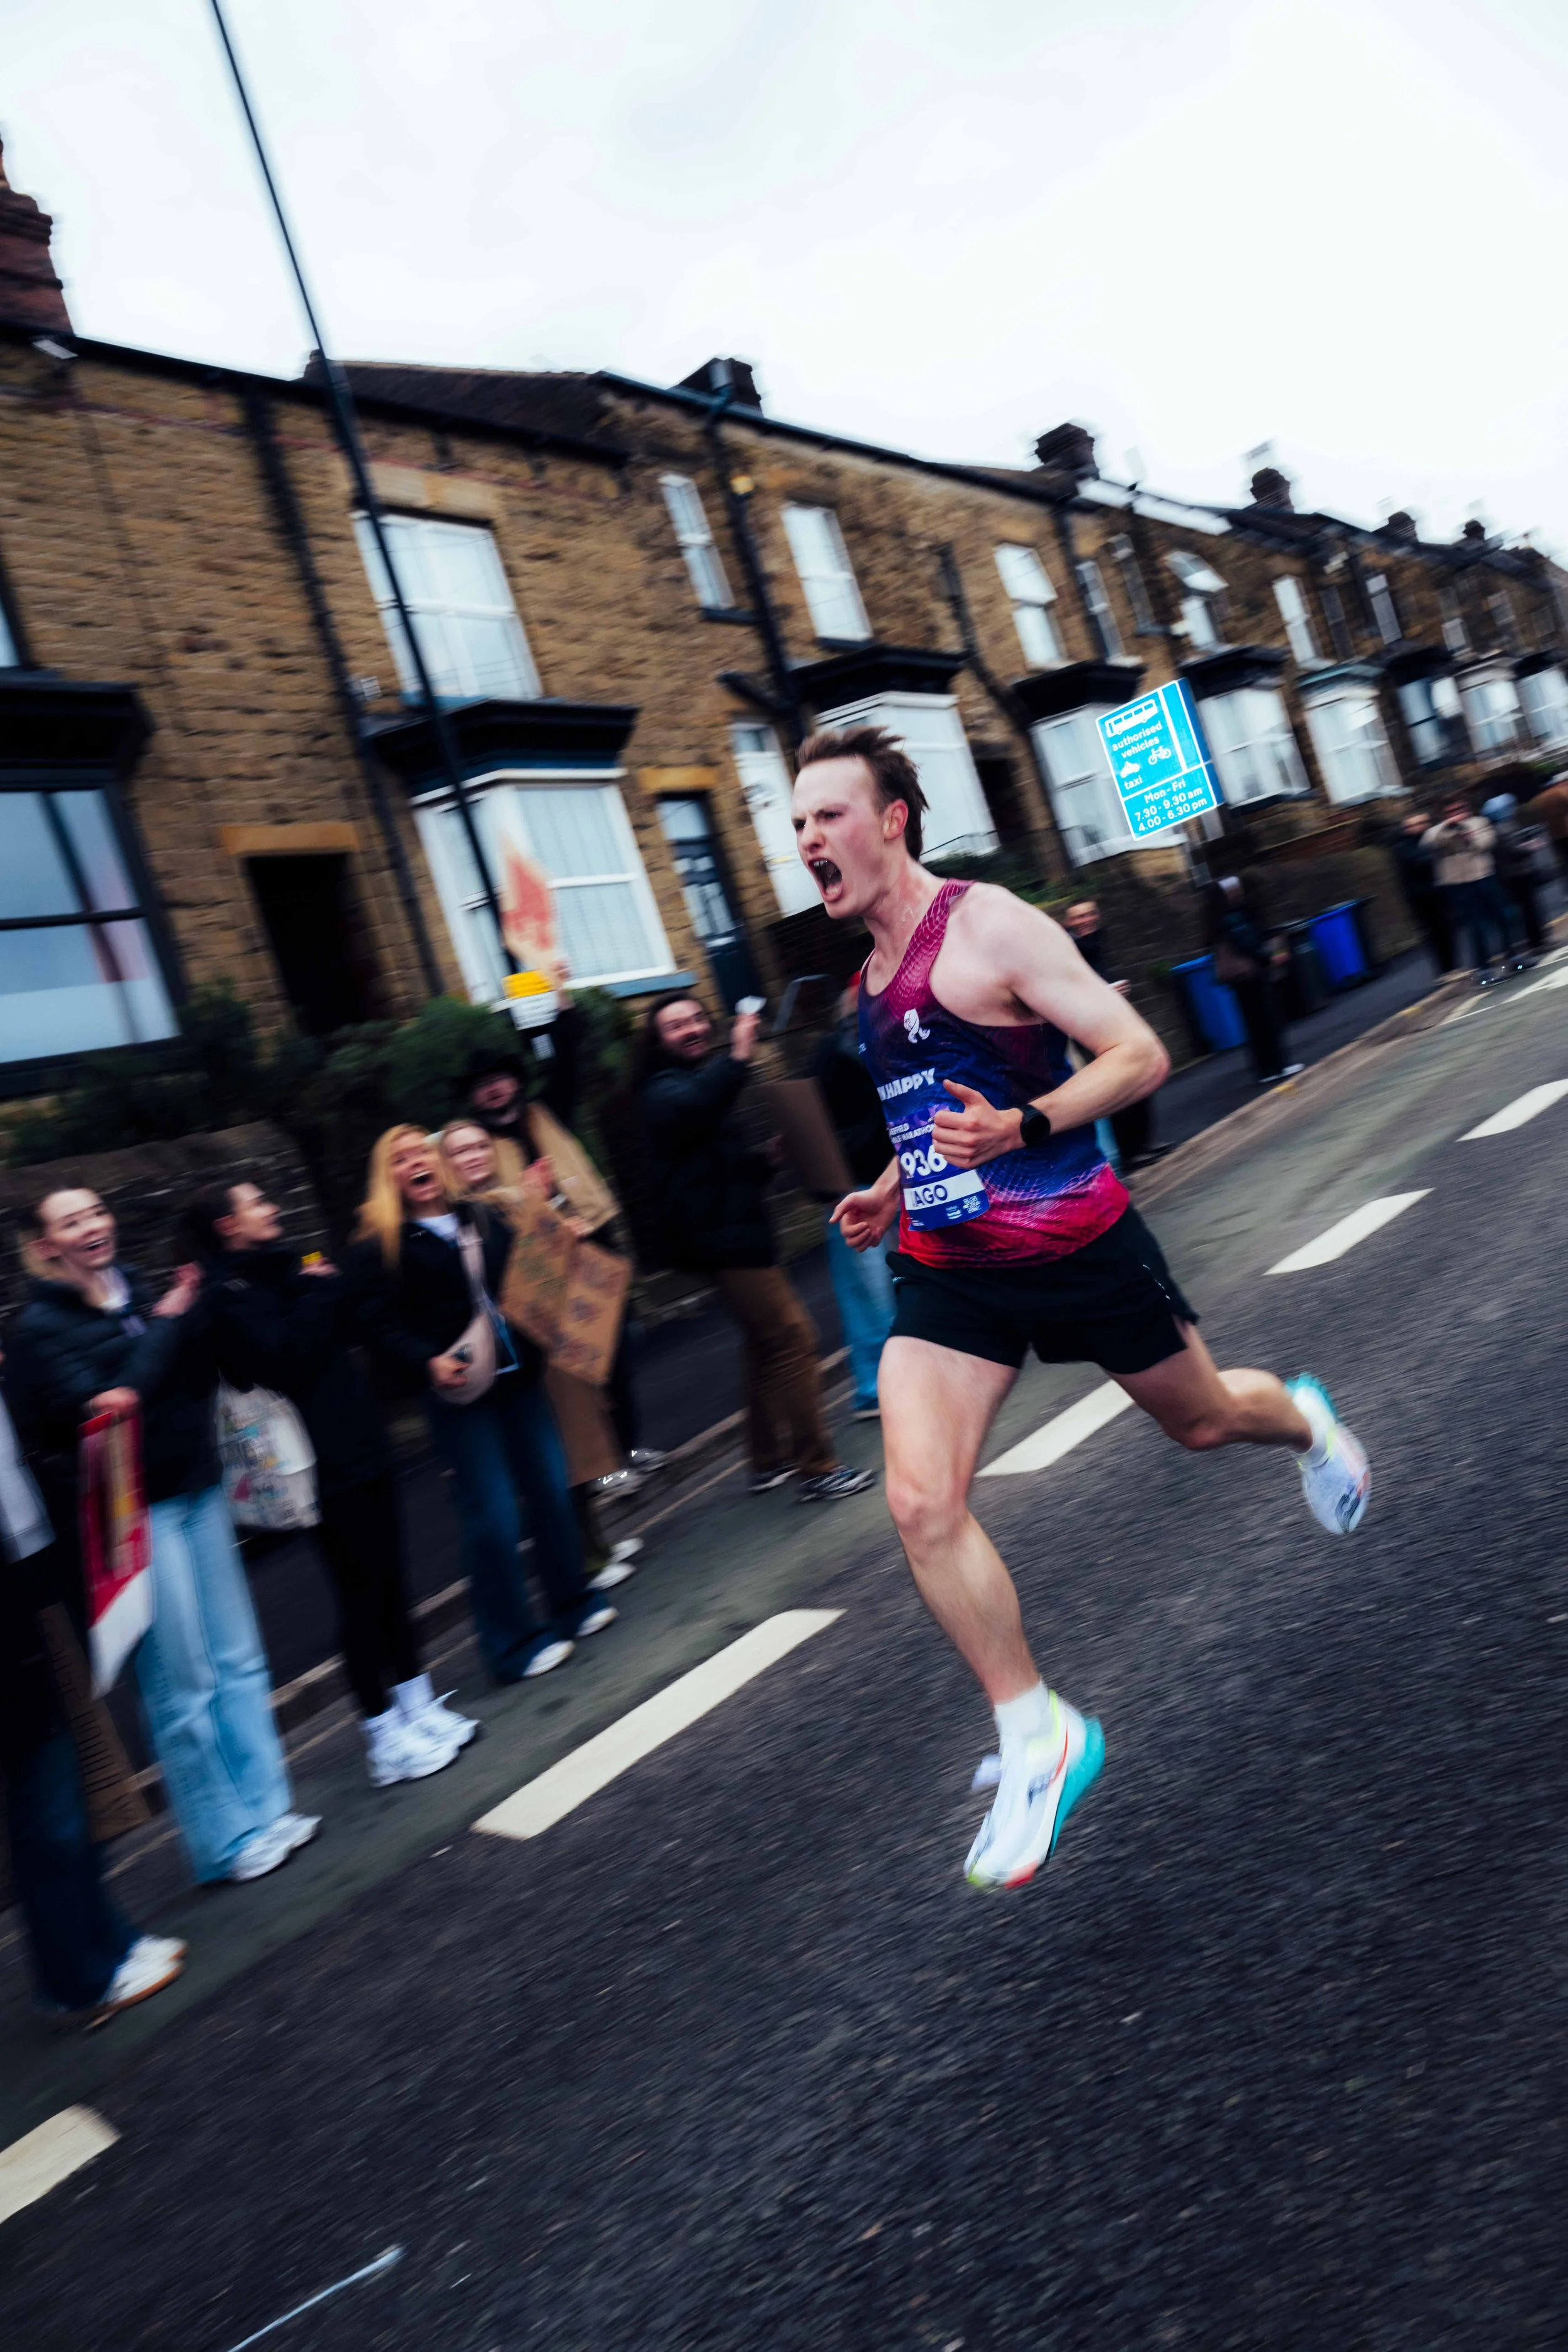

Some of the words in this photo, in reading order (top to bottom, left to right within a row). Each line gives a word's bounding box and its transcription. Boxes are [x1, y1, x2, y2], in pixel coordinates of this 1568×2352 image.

[1112, 721, 1163, 751] authorised
[1121, 736, 1160, 759] vehicles
[1124, 775, 1143, 790] taxi
[1144, 790, 1167, 804] Mon
[1172, 778, 1186, 792] Fri
[1135, 805, 1158, 822] 7.30
[1163, 792, 1187, 810] 9.30
[1187, 788, 1203, 799] am
[1138, 815, 1162, 832] 4.00
[1167, 803, 1190, 820] 6.30
[1192, 798, 1207, 812] pm
